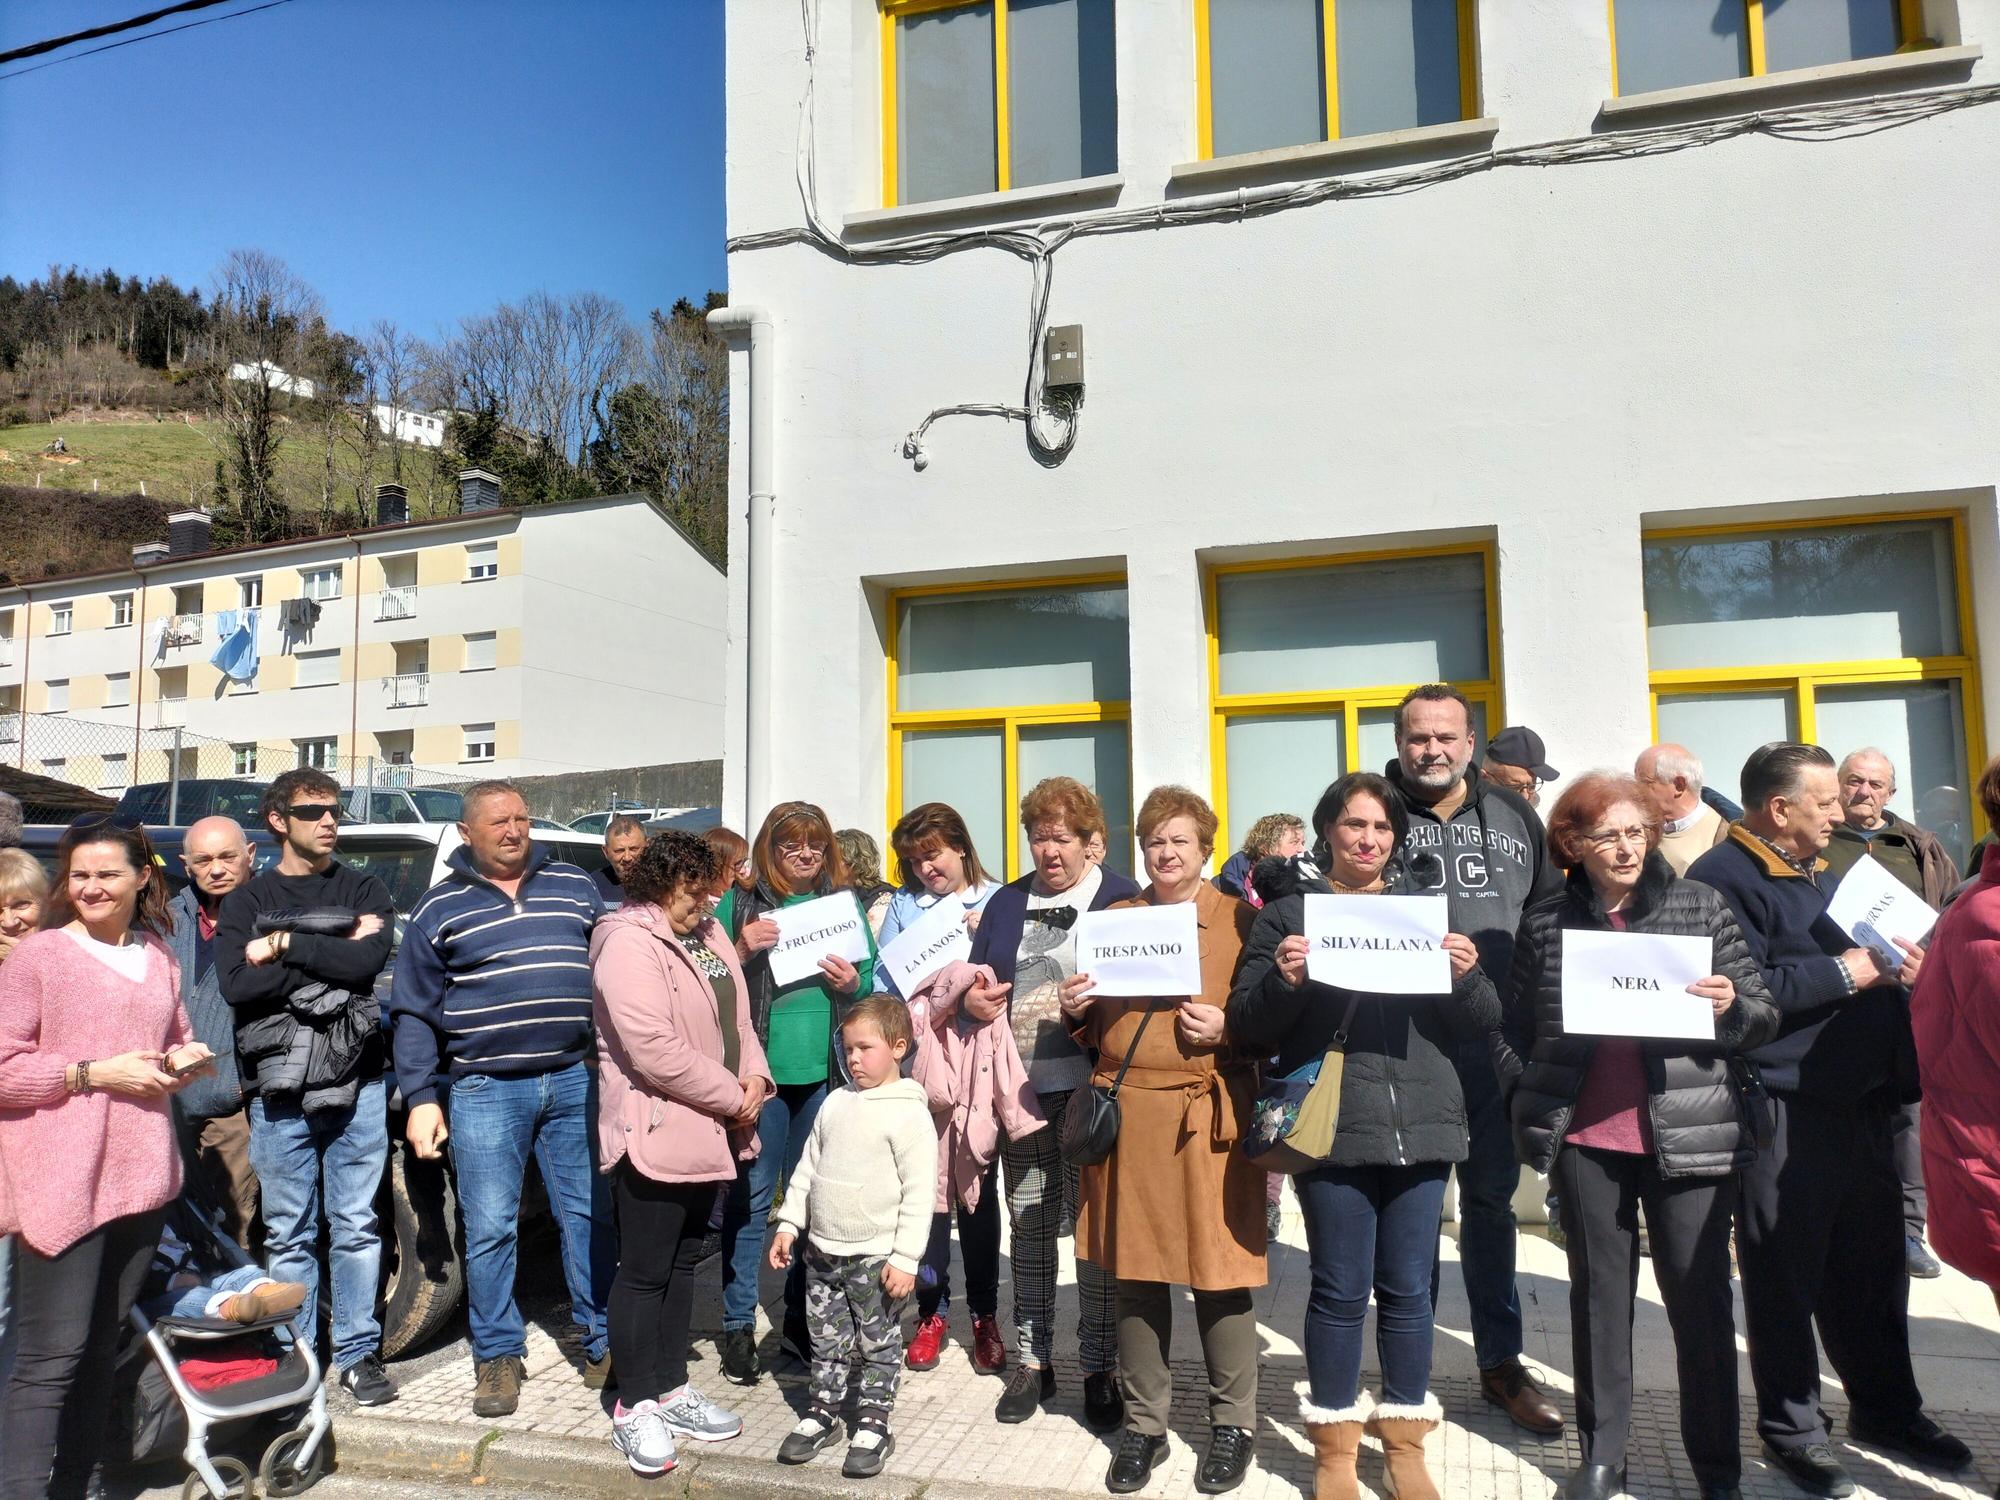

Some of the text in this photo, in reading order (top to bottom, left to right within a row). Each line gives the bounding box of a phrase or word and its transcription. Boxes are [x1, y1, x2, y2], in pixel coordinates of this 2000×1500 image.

[1404, 823, 1527, 866] SHINGTON
[1475, 890, 1500, 898] CAPITAL
[785, 920, 857, 950] FRUCTUOSO
[1321, 935, 1433, 952] SILVALLANA
[905, 928, 963, 974] LA FANOSA
[1092, 942, 1182, 959] TRESPANDO
[1610, 976, 1661, 991] NERA
